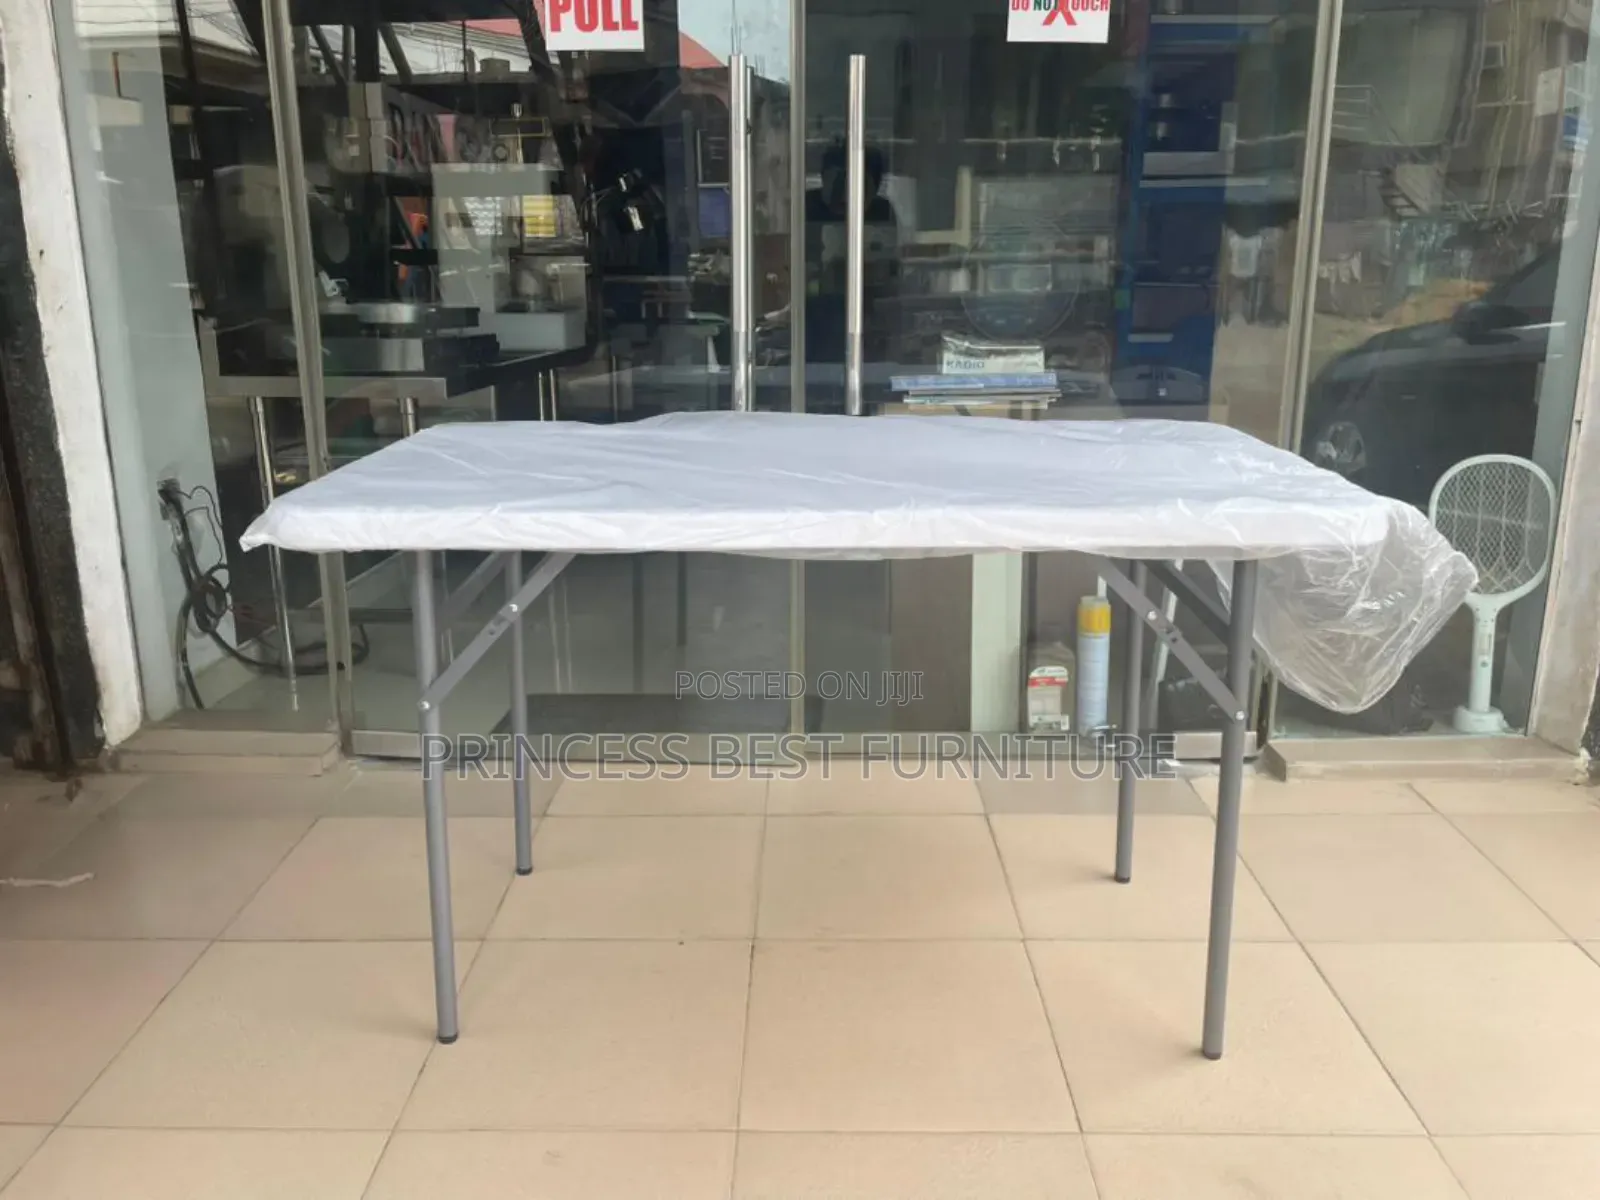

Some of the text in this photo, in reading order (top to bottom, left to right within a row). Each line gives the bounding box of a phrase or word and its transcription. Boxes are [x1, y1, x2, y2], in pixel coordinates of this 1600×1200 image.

[550, 0, 639, 32] PULL
[1011, 0, 1029, 11] DO
[1061, 0, 1109, 11] OUCH
